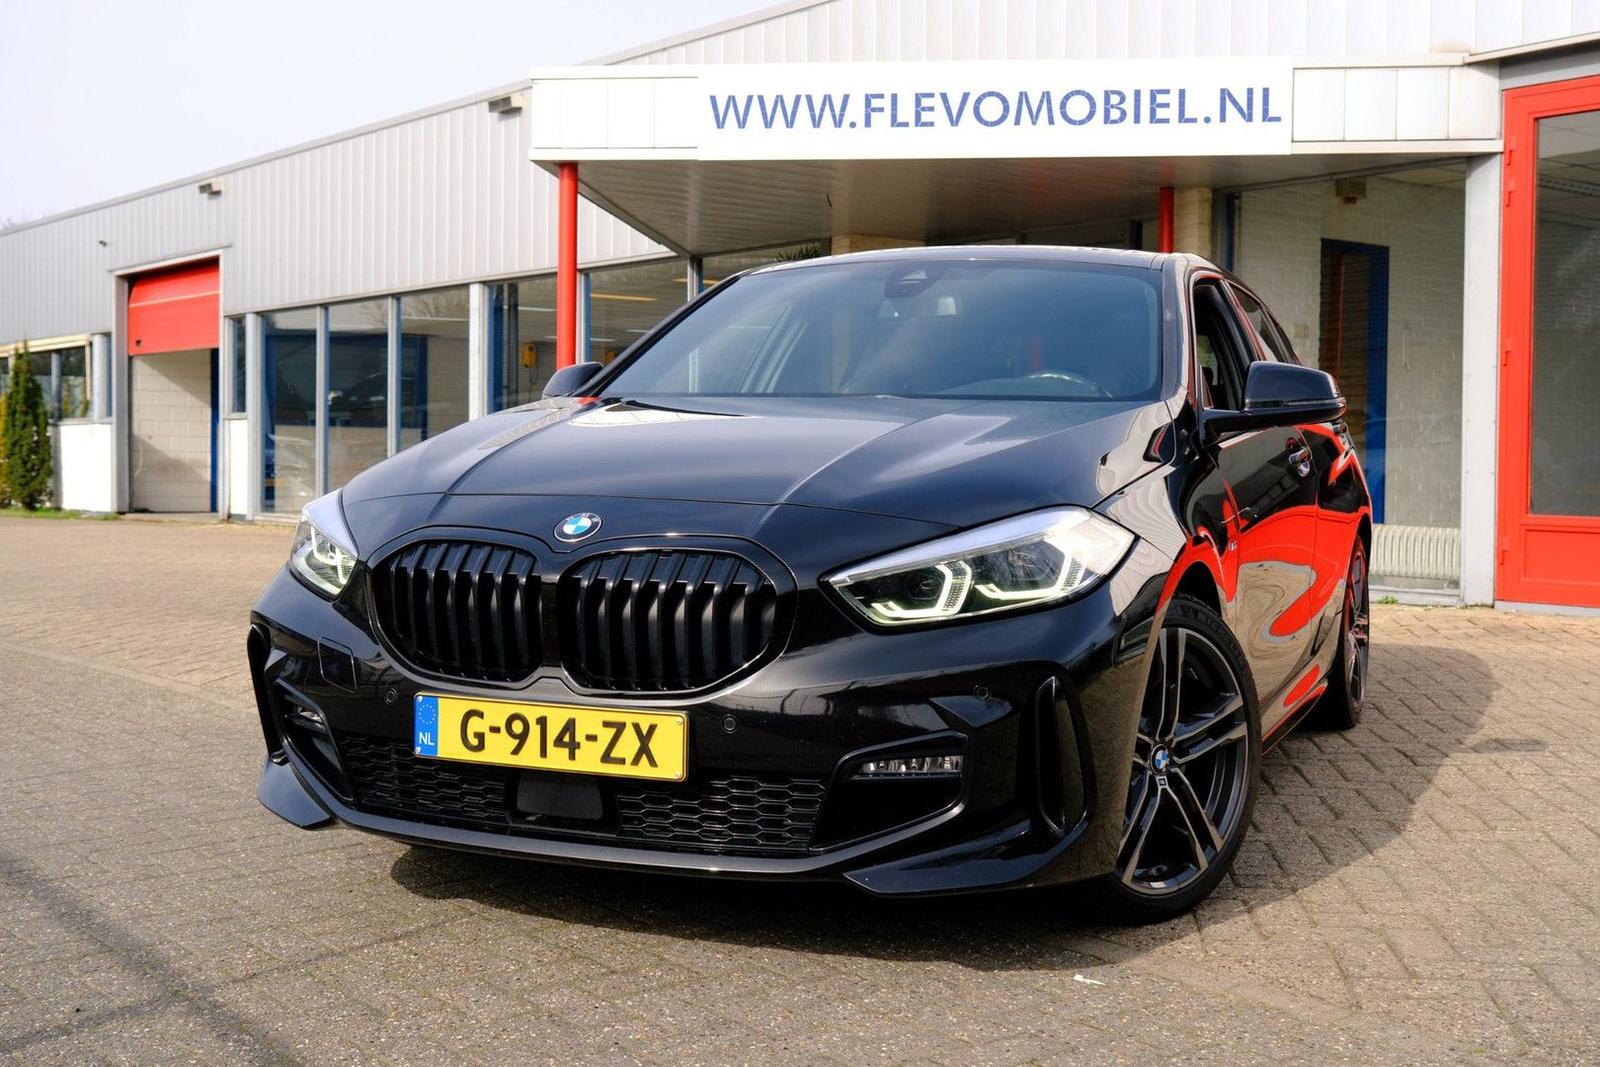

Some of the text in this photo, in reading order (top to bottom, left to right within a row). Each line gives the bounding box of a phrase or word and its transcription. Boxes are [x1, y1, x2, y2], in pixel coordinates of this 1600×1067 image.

[709, 87, 1281, 129] WWW.FLEVOMOBIEL.NL
[418, 731, 435, 746] NL
[460, 709, 658, 767] G-914-ZX
